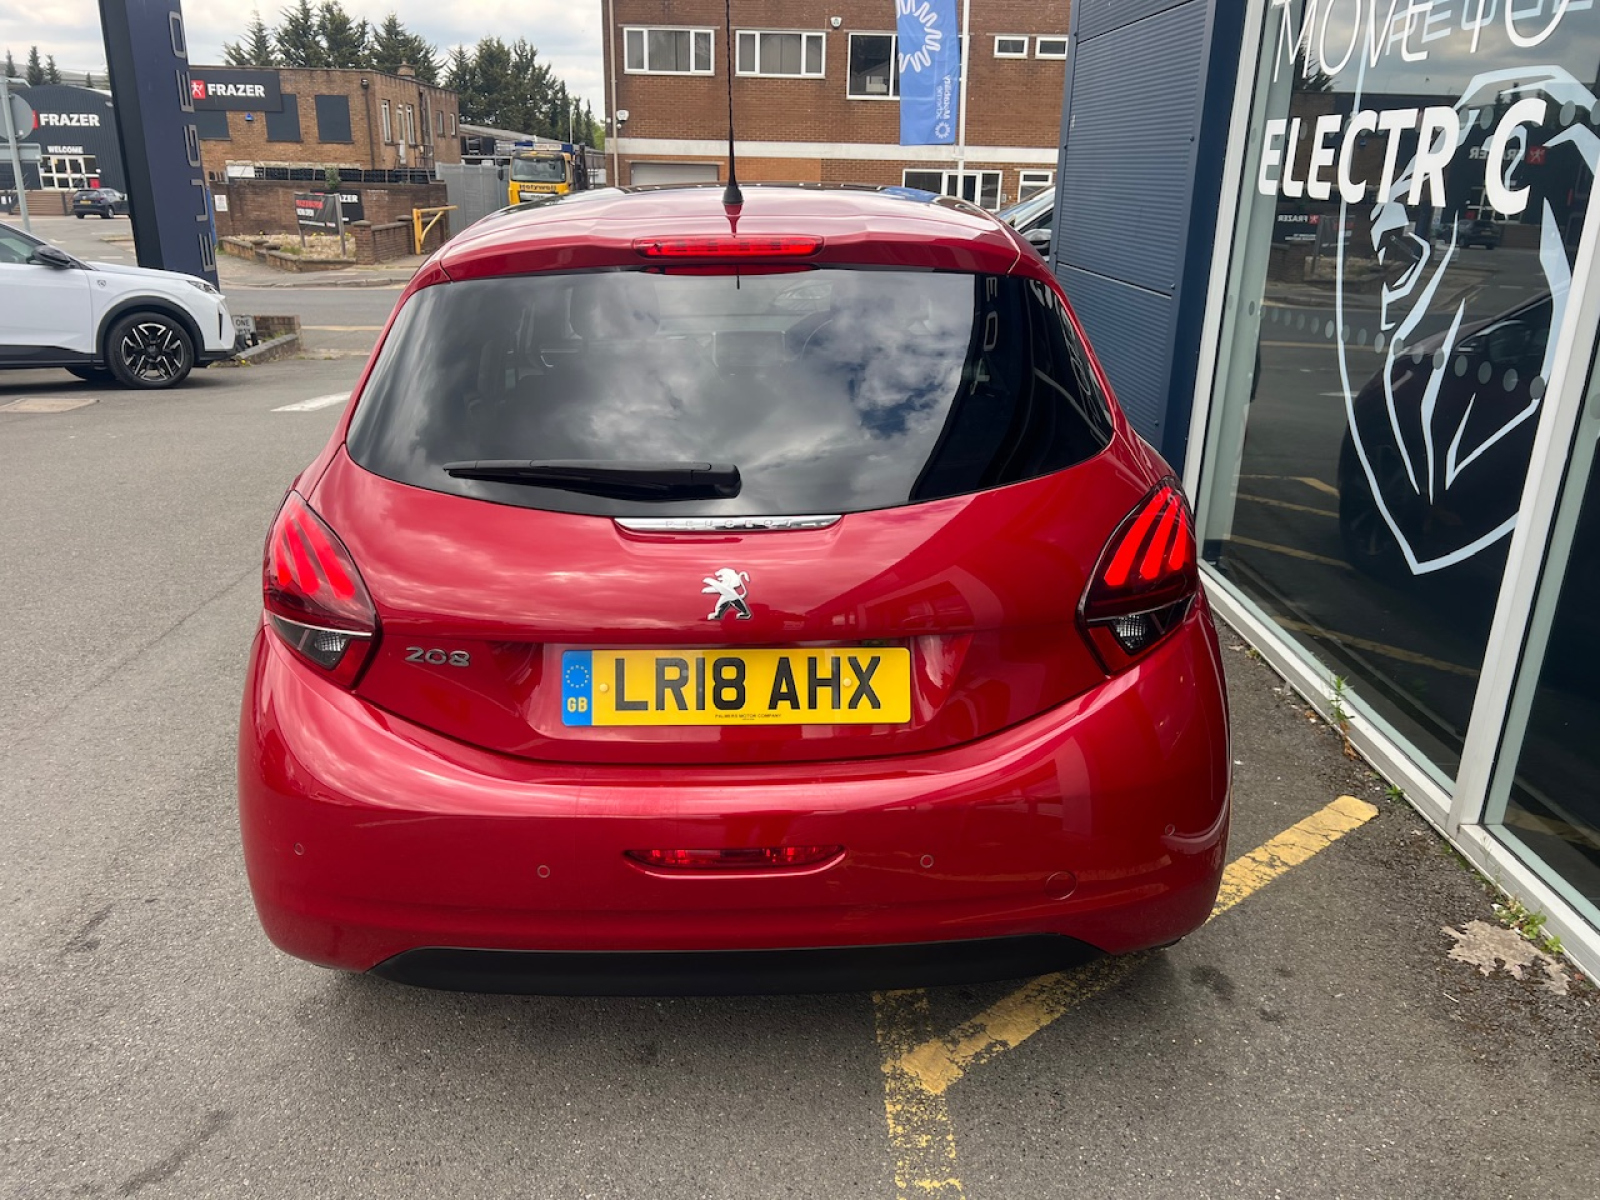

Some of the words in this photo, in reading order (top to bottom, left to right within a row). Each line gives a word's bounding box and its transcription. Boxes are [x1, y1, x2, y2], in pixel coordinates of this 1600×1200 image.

[206, 83, 266, 98] FRAZER
[39, 113, 101, 126] FRAZER
[168, 10, 215, 272] EUGEO
[47, 145, 84, 154] WELCOME
[1258, 97, 1547, 215] ELECTRC
[340, 194, 359, 203] ZER
[665, 519, 793, 528] PEUGEOT
[405, 646, 471, 668] 208
[615, 656, 746, 711] LR18
[768, 655, 881, 710] AHX
[566, 697, 589, 714] GB
